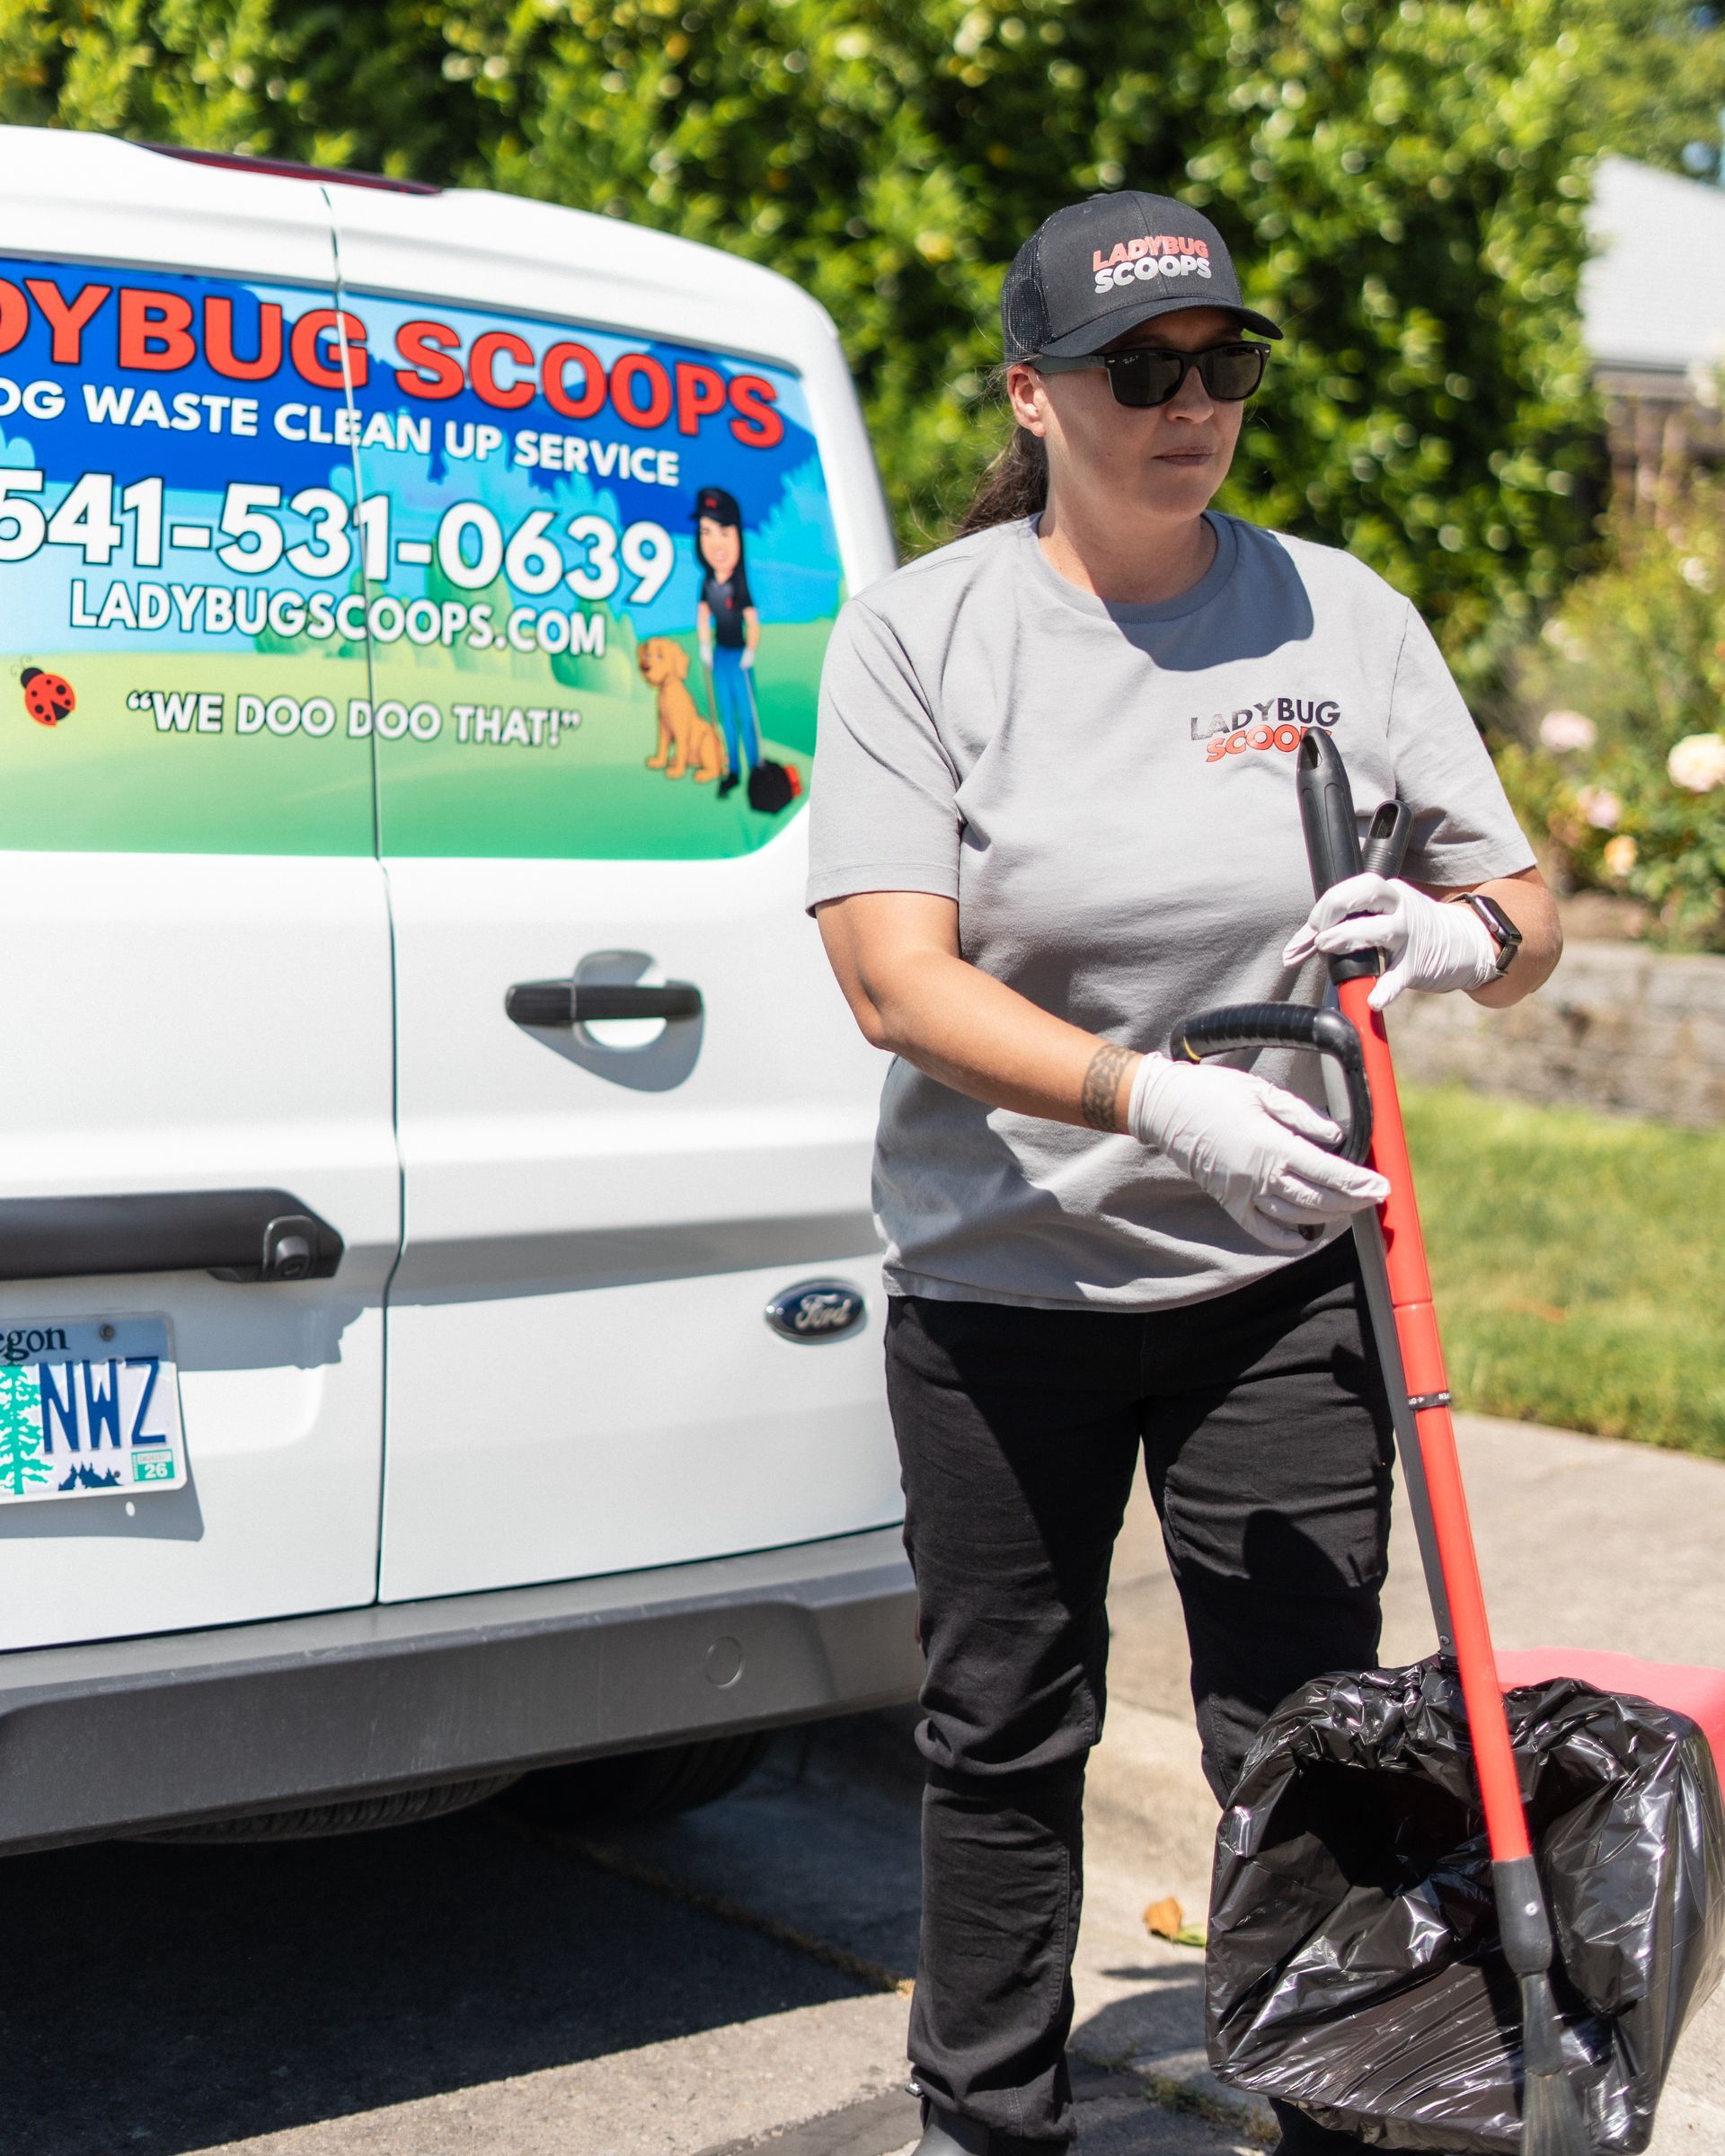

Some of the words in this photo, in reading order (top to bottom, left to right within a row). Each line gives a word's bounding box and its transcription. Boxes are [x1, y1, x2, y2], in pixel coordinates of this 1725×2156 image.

[1092, 235, 1208, 272] LADYBUG
[1094, 255, 1212, 294] SCOOPS
[394, 320, 784, 449] SCOOPS
[83, 384, 259, 437] WASTE
[273, 402, 431, 455] CLEAN
[444, 421, 502, 461] UP
[514, 430, 680, 487] SERVICE
[0, 466, 675, 606] 541-531-0639
[70, 579, 606, 657] LADYBUGSCOOPS.COM
[235, 695, 336, 737] DOO
[348, 699, 442, 742] DOO
[1190, 697, 1341, 741] LADYBUG
[1206, 723, 1332, 762] SCOO
[795, 1294, 852, 1330] Ford
[39, 1356, 166, 1454] NWZ
[144, 1462, 169, 1480] 26
